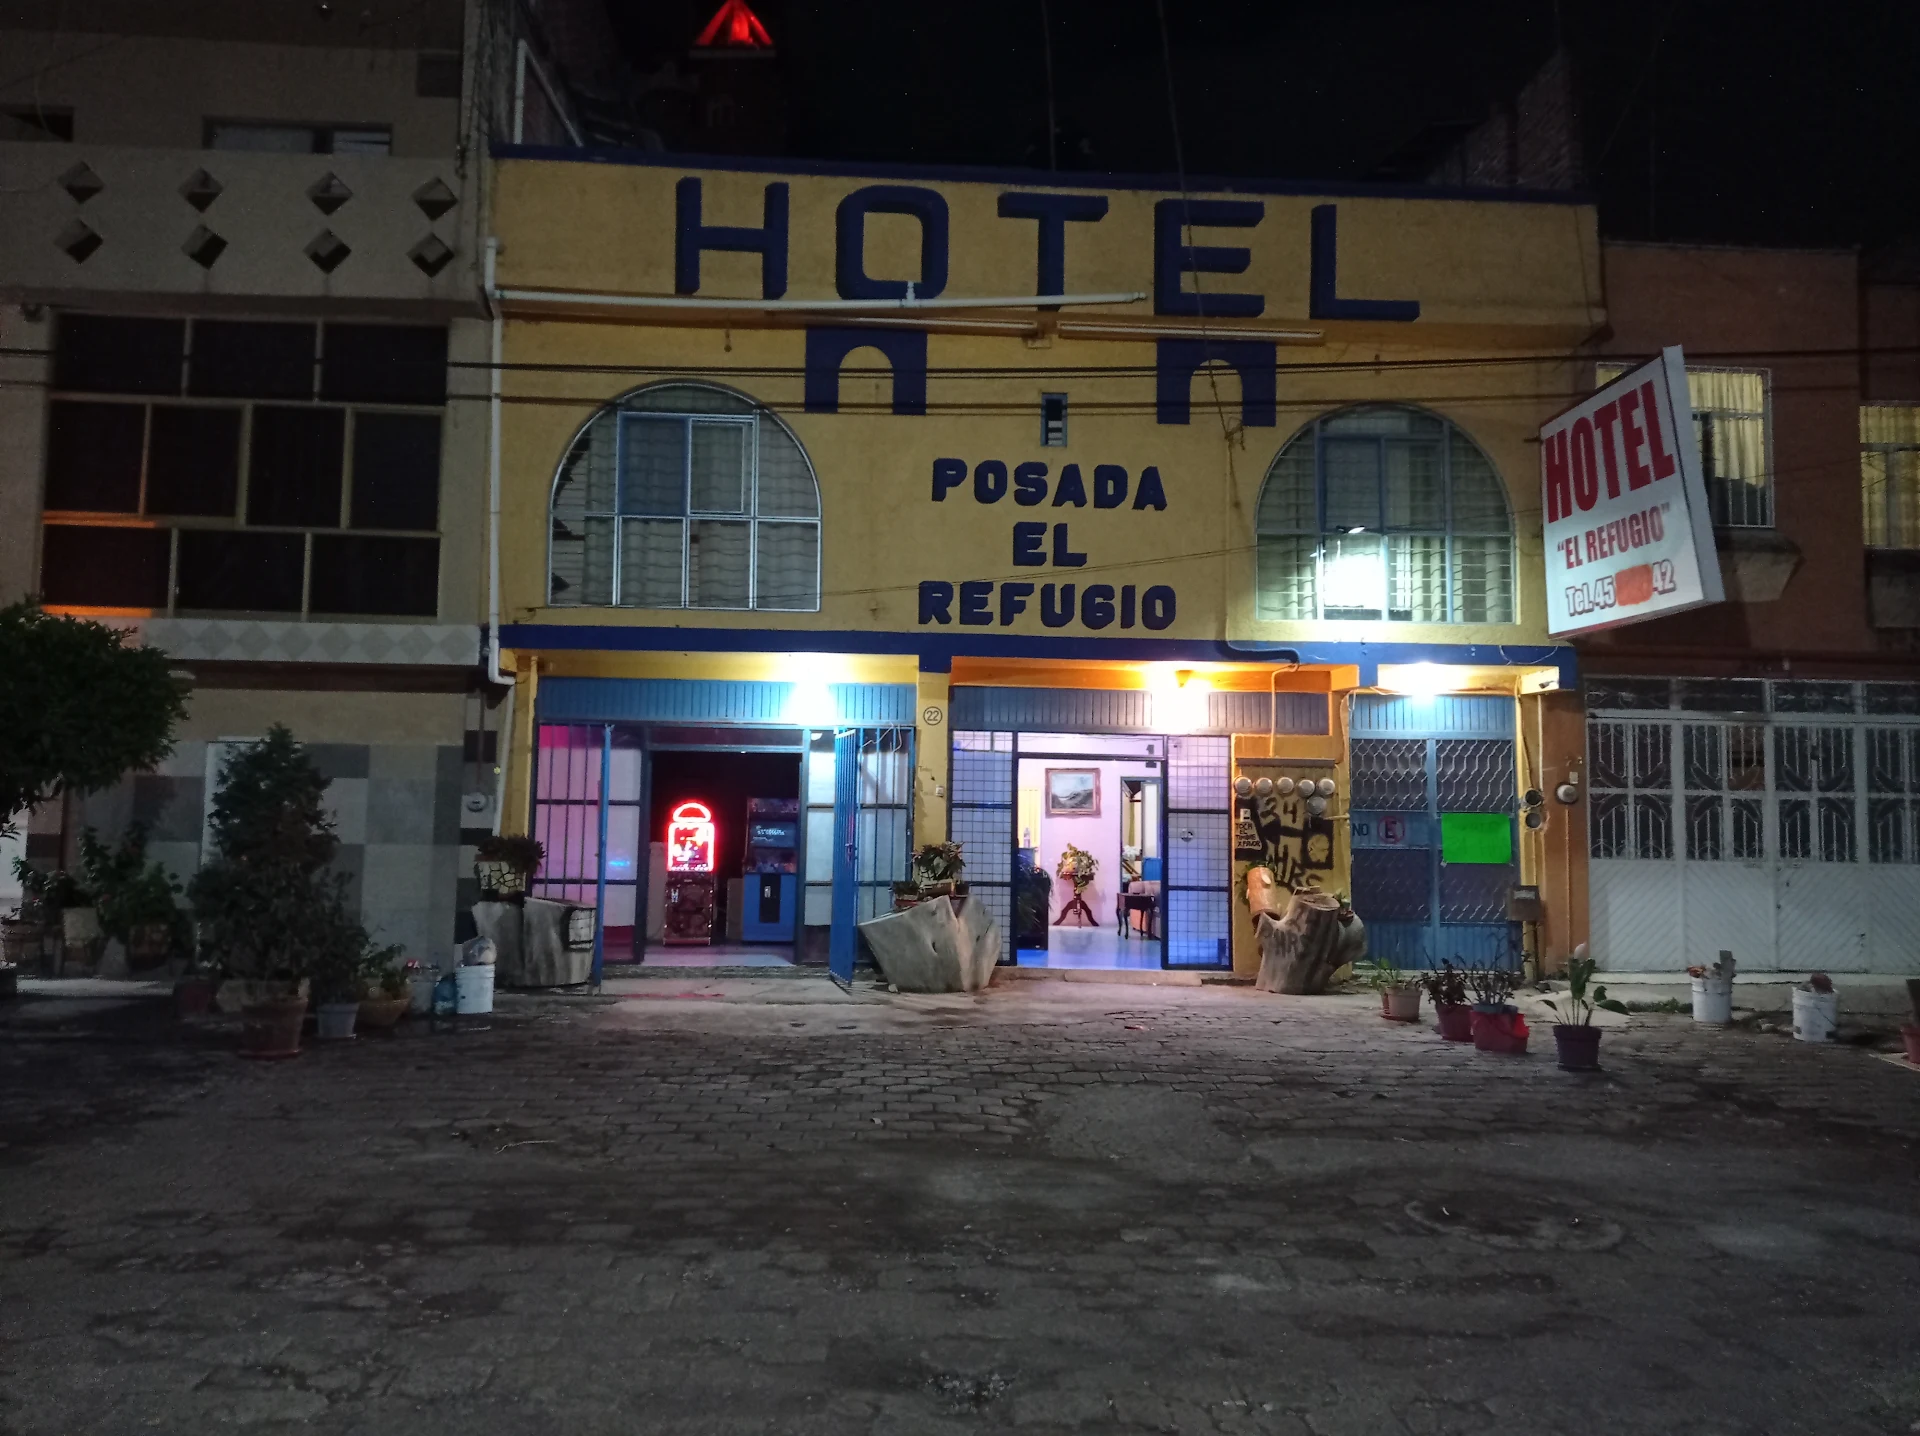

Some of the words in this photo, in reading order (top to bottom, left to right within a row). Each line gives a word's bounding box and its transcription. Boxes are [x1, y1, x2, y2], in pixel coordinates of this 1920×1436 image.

[674, 176, 1420, 322] HOTEL
[1544, 379, 1676, 524] HOTEL
[931, 458, 1168, 511] POSADA
[1012, 521, 1088, 567] EL
[918, 580, 1177, 630] REFUGIO
[926, 710, 940, 721] 22
[1260, 797, 1298, 824] 24
[1352, 823, 1369, 837] NO
